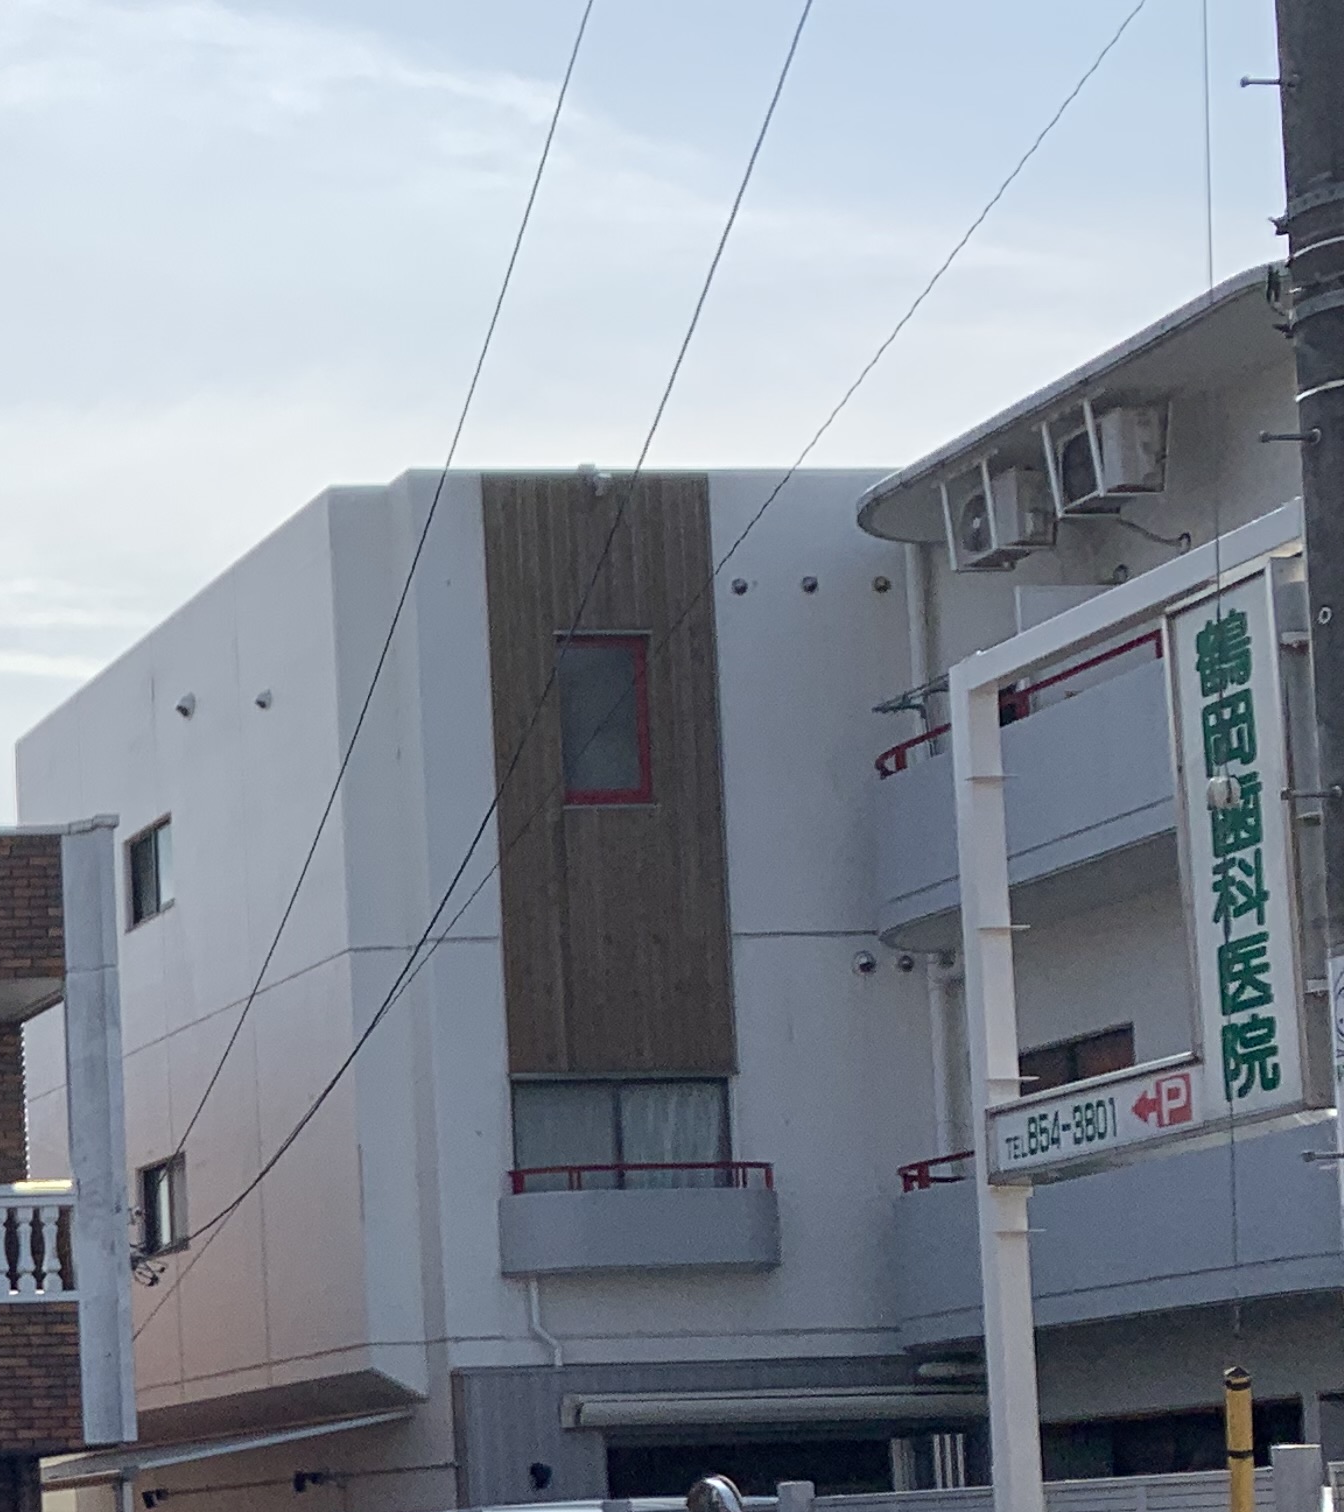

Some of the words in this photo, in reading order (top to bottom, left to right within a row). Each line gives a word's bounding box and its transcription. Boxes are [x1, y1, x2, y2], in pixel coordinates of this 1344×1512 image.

[1196, 608, 1279, 1102] 鶴岡歯科医院
[1162, 1076, 1188, 1126] P
